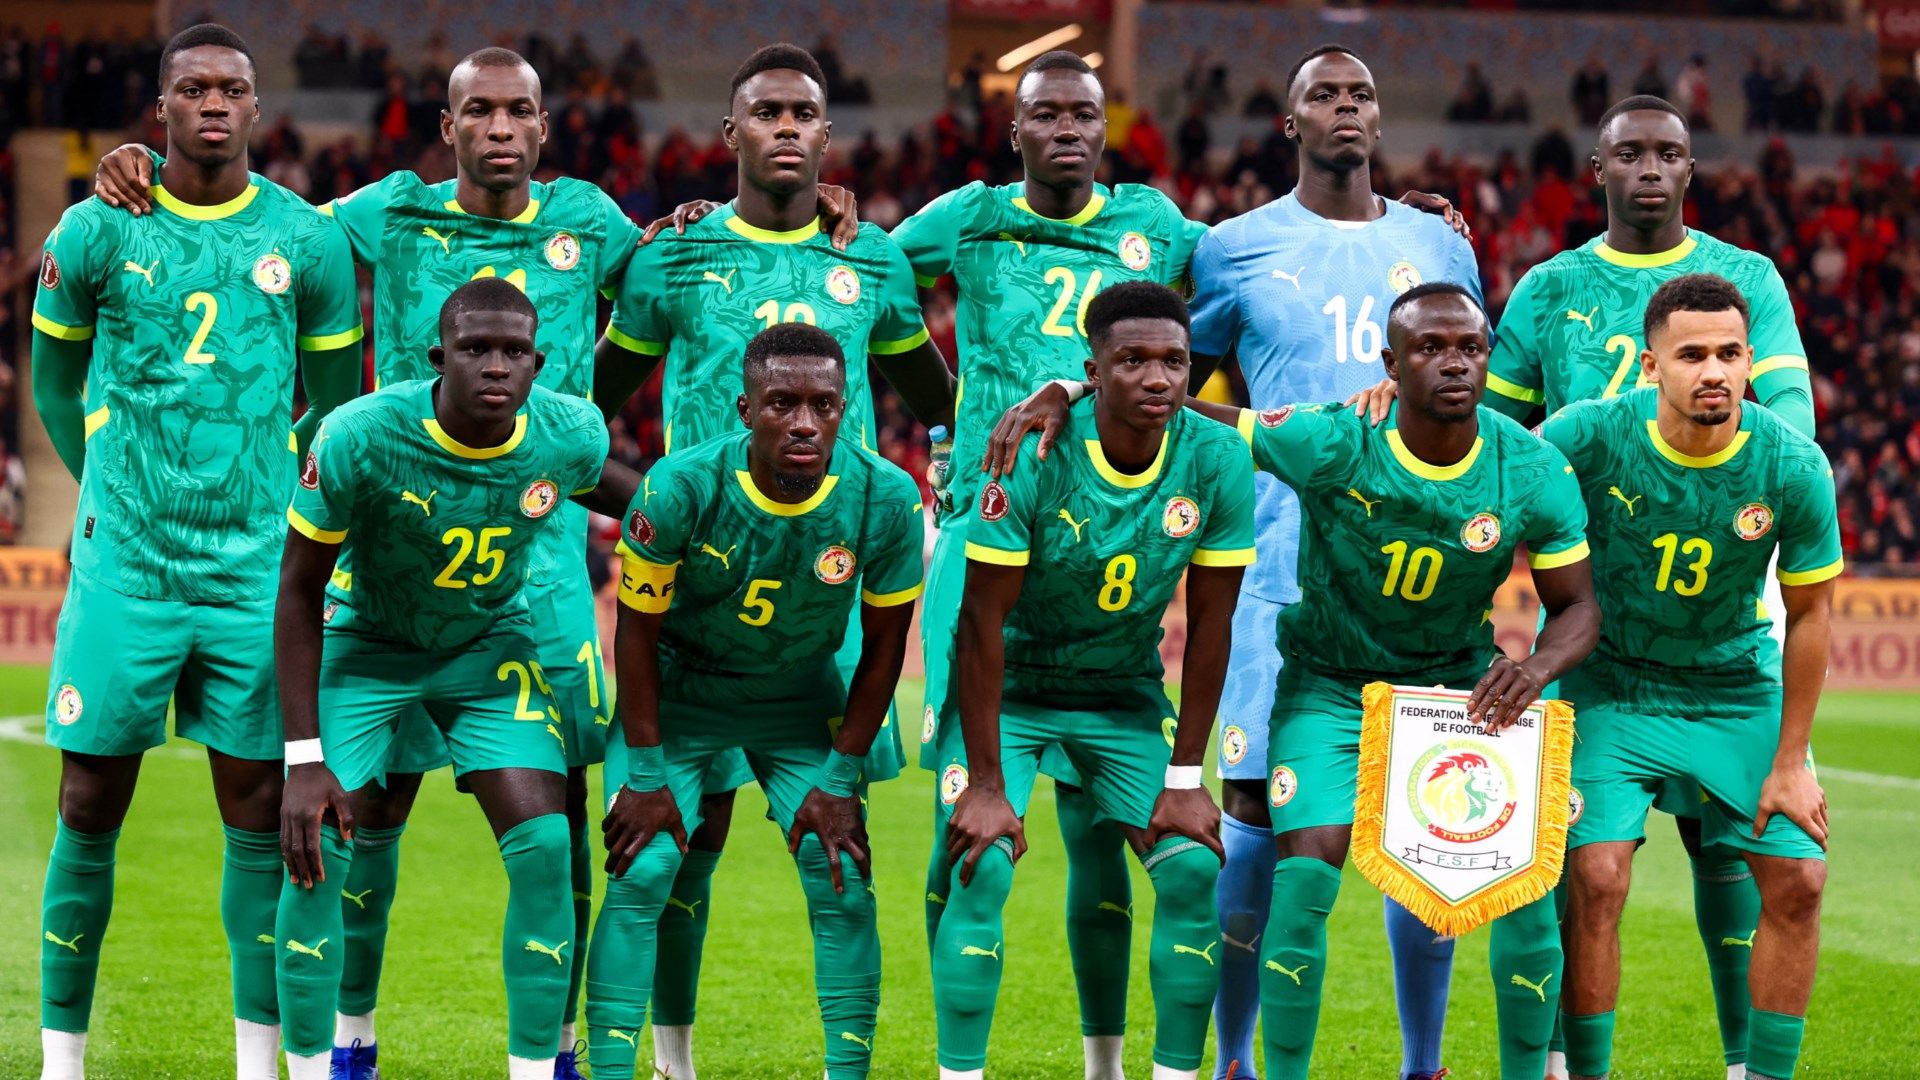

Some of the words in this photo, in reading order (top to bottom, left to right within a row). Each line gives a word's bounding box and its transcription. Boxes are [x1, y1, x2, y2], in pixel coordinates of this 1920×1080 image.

[184, 292, 218, 364] 2
[1322, 294, 1382, 364] 16
[433, 526, 512, 589] 25
[1097, 554, 1137, 612] 8
[1381, 540, 1444, 601] 10
[1652, 533, 1713, 596] 13
[738, 579, 782, 626] 5
[1400, 706, 1465, 720] FEDERATION
[1433, 722, 1448, 732] DE
[1436, 854, 1479, 867] F.S.F
